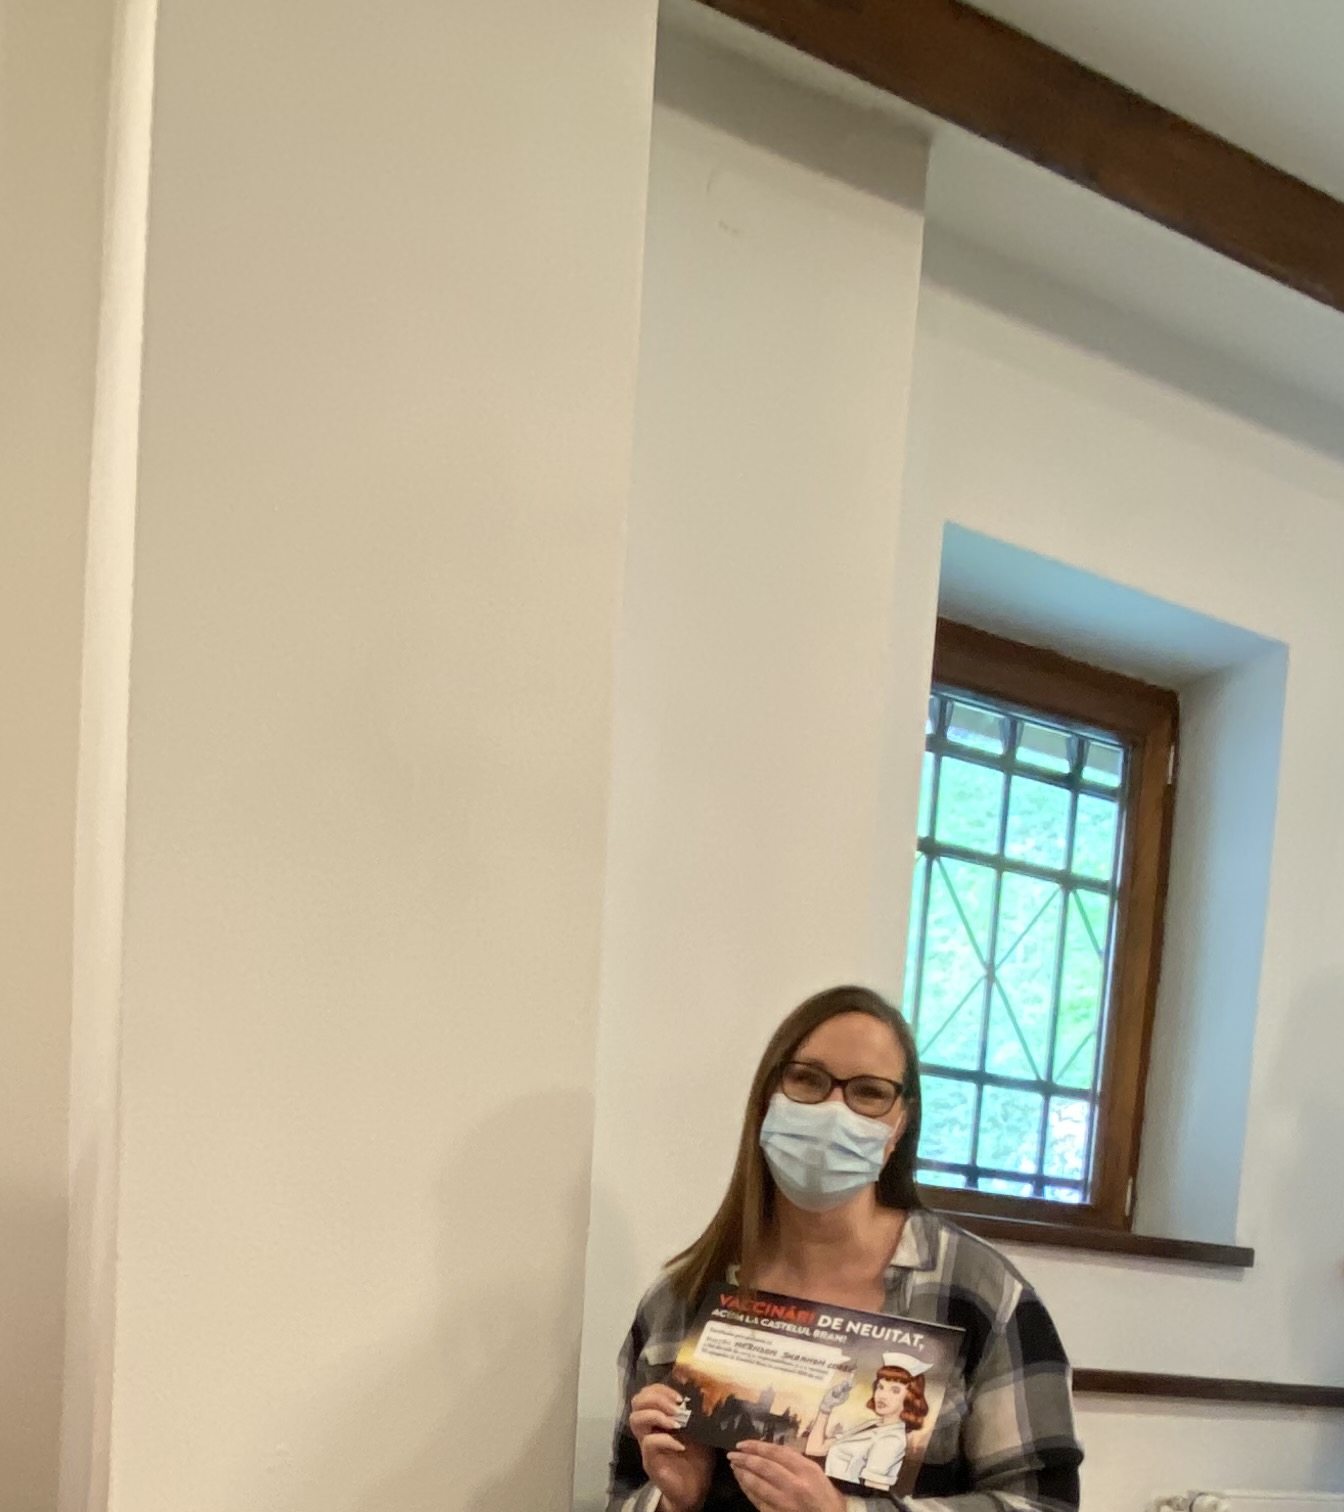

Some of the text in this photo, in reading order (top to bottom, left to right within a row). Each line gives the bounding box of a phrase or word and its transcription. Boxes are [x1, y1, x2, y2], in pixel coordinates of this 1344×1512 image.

[745, 1315, 759, 1325] LA
[760, 1318, 811, 1336] CASTELUL
[812, 1328, 847, 1344] BRAN!
[817, 1314, 842, 1332] DE
[846, 1320, 925, 1351] NEUITAT,
